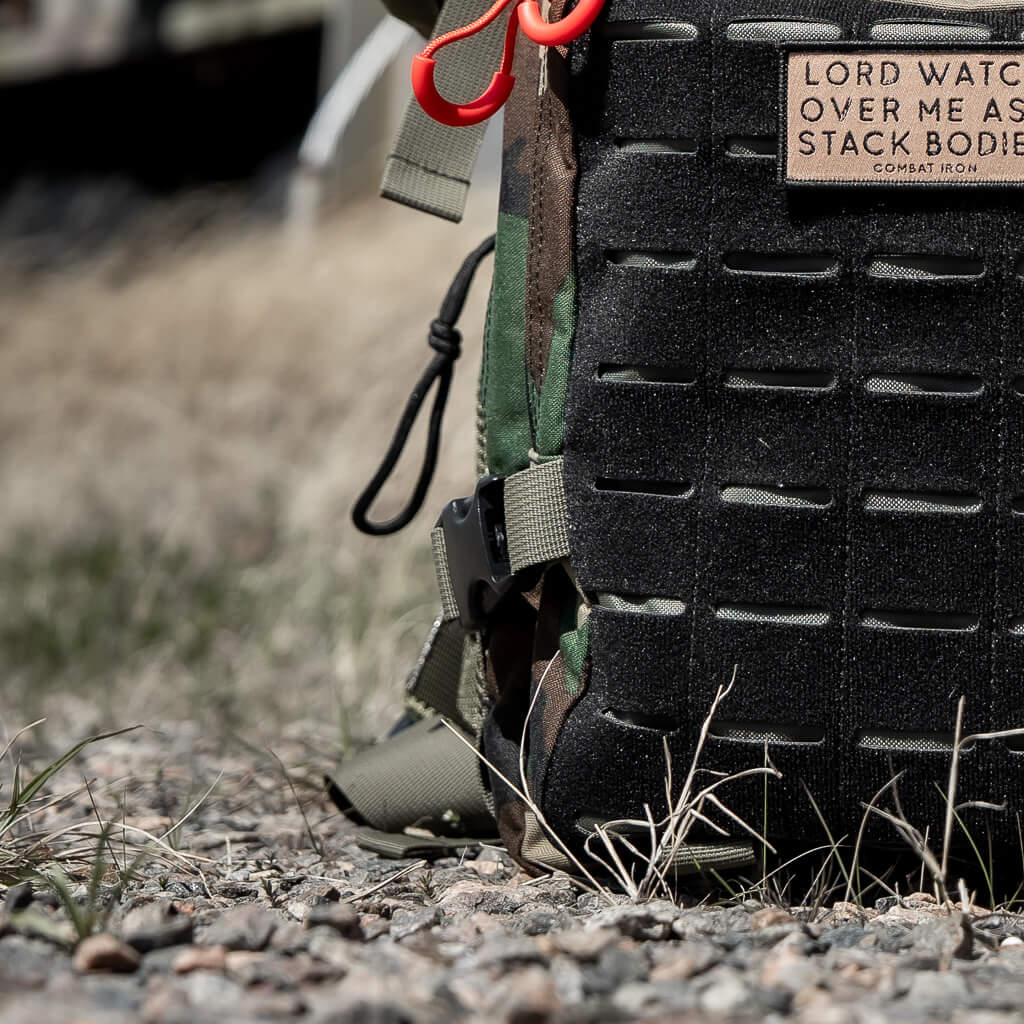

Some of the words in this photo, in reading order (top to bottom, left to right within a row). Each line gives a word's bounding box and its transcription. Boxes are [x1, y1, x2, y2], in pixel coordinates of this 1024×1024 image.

[804, 60, 901, 86] LORD
[800, 97, 901, 123] OVER
[918, 97, 964, 123] ME
[798, 130, 911, 157] STACK
[873, 163, 934, 174] COMBAT
[940, 163, 978, 175] IRON
